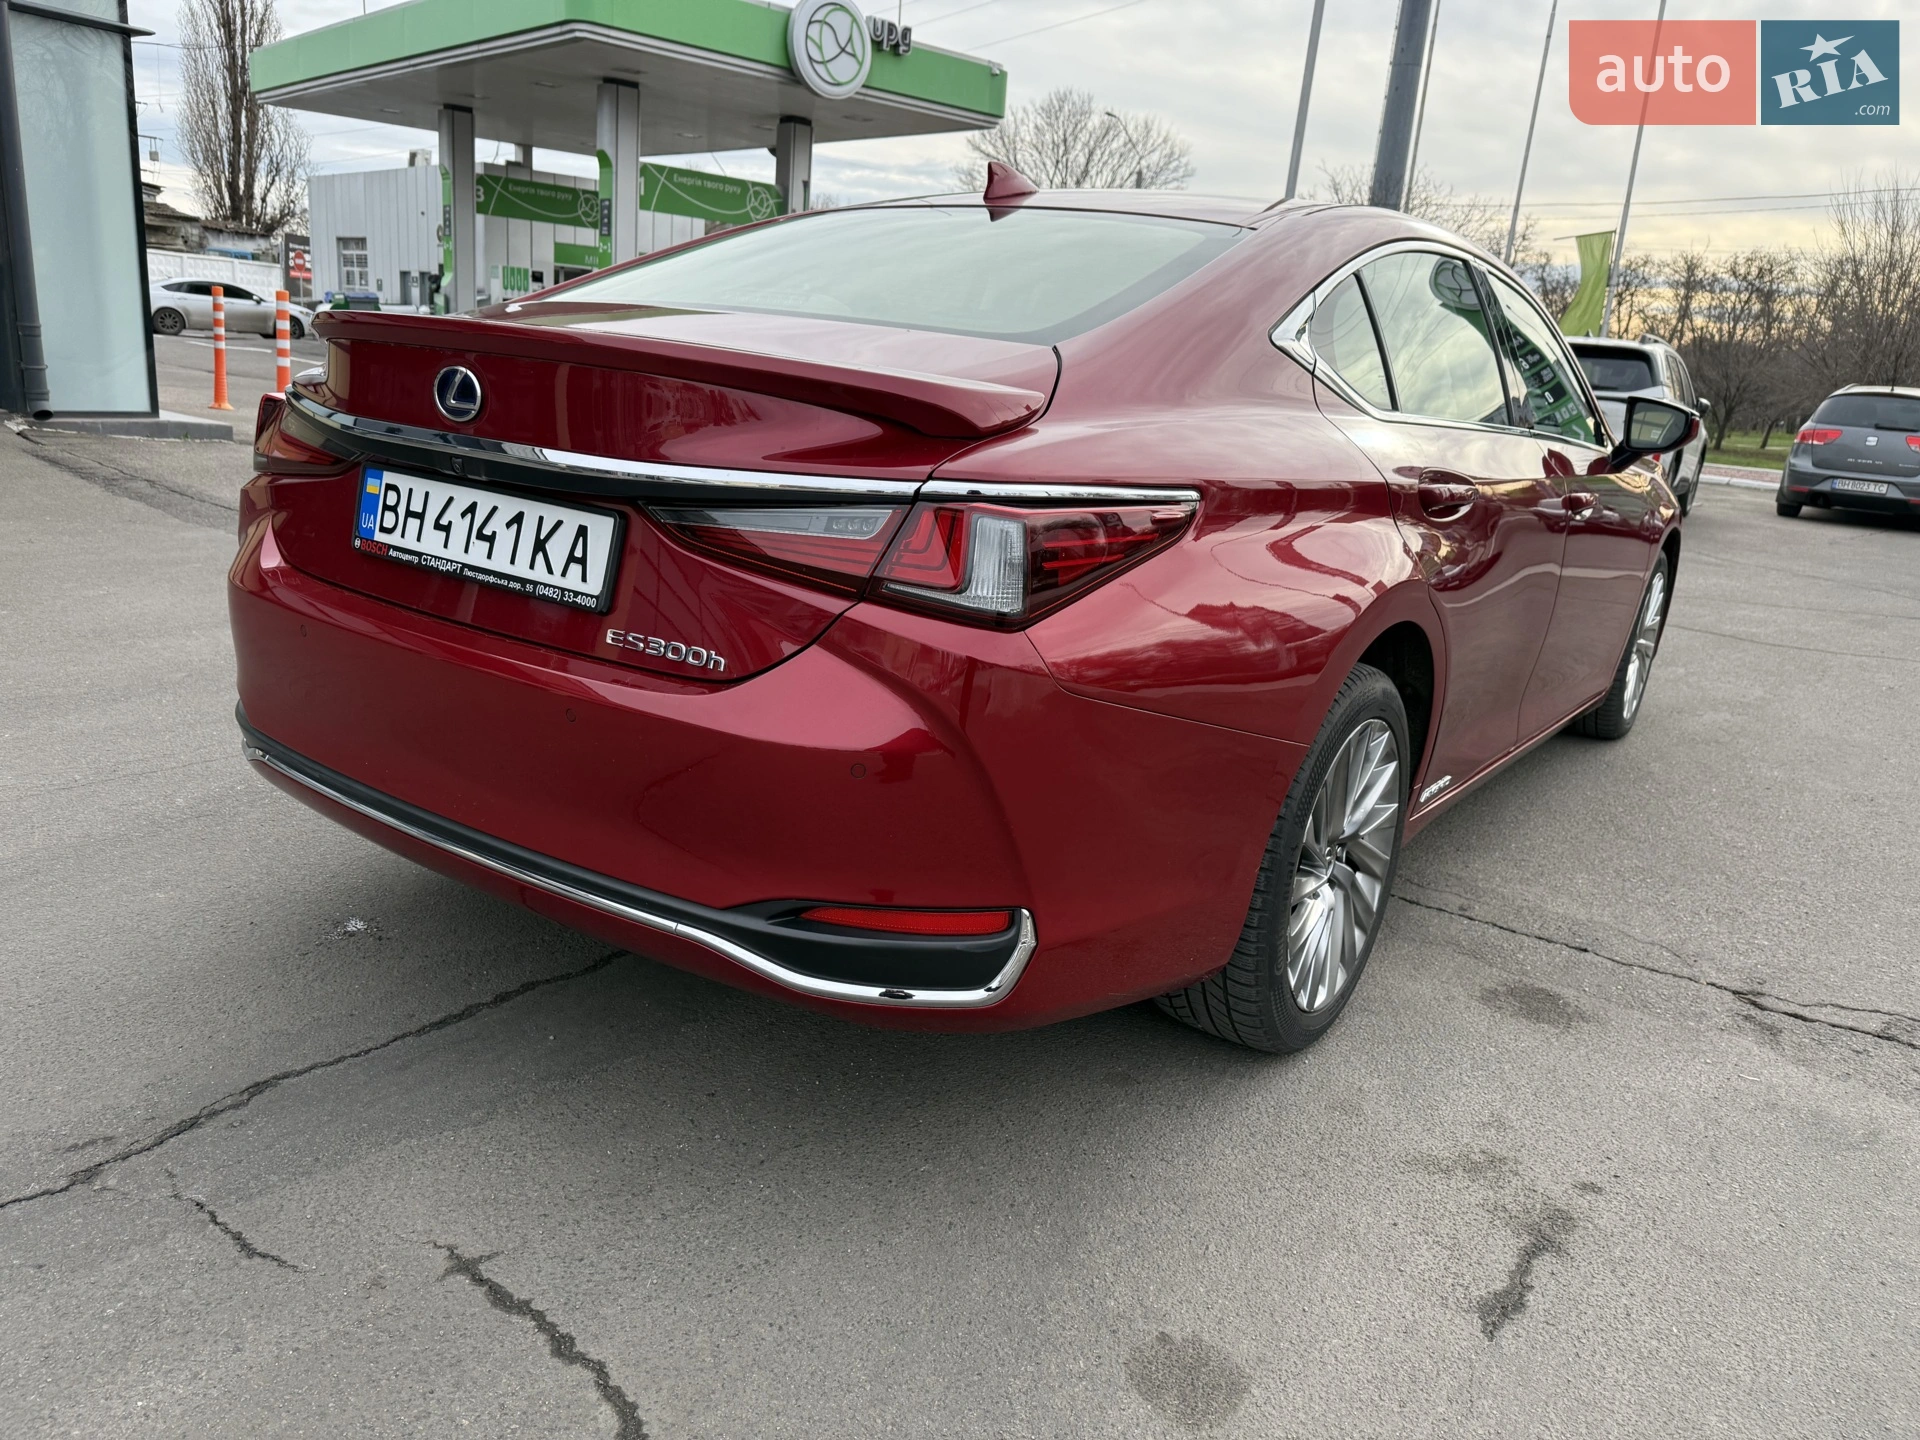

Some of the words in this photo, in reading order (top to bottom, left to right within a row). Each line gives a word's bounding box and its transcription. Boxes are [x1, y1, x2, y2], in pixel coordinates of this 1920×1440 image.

[870, 16, 912, 54] upg
[361, 512, 375, 530] UA
[360, 538, 388, 556] BOSCH
[388, 548, 419, 564] Автоцентр
[421, 554, 462, 573] СТАНДАРТ
[463, 568, 508, 586] Люстдорфська
[525, 583, 534, 592] 55
[535, 584, 562, 601] (0482)
[563, 591, 597, 608] 33-4000
[605, 628, 725, 672] ES300h
